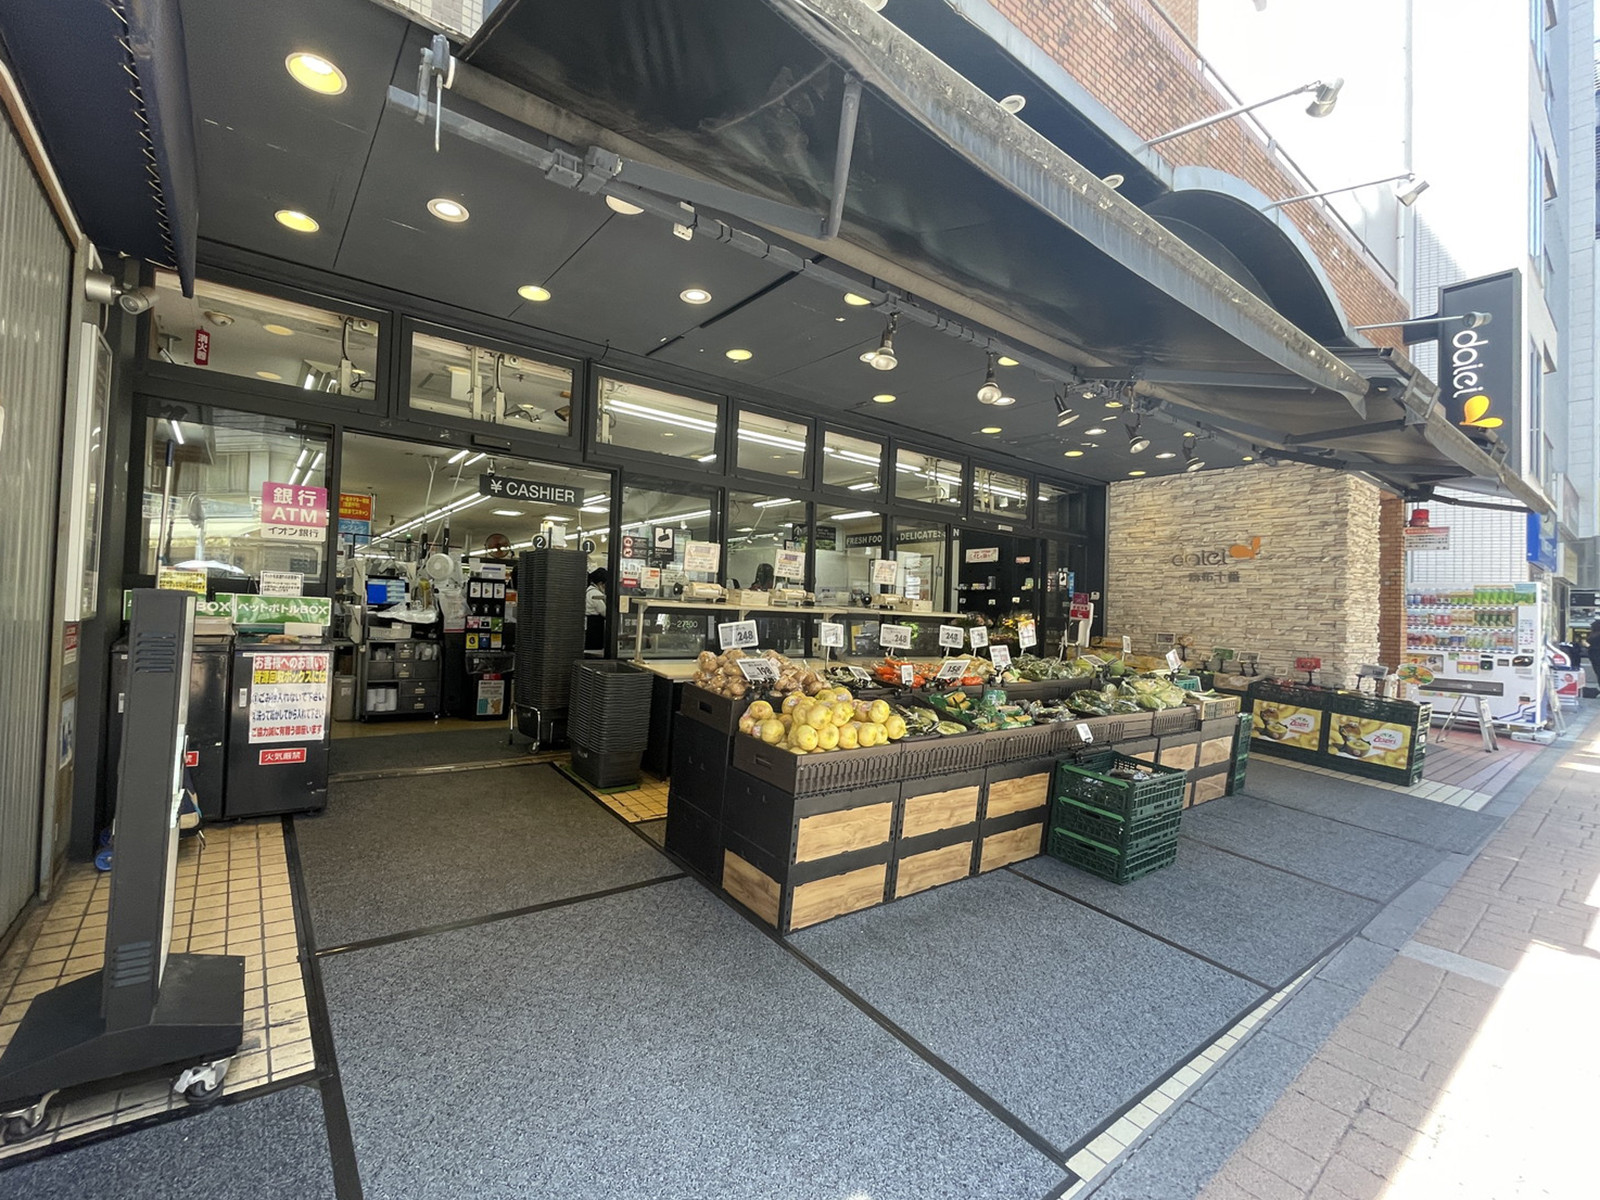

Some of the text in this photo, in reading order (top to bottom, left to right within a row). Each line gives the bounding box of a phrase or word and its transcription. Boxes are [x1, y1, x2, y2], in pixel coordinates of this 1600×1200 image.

[197, 333, 208, 361] 消火器
[273, 487, 317, 507] 銀行
[506, 481, 575, 503] CASHIER
[271, 506, 318, 523] ATM
[268, 526, 320, 539] イオン銀行
[536, 536, 543, 548] 2
[846, 535, 868, 545] FRESH
[585, 541, 591, 552] 1
[238, 602, 330, 615] ペットボトルBOX
[737, 630, 754, 641] 248
[894, 634, 907, 643] 248
[756, 666, 773, 676] 198
[265, 751, 301, 761] 火気厳禁
